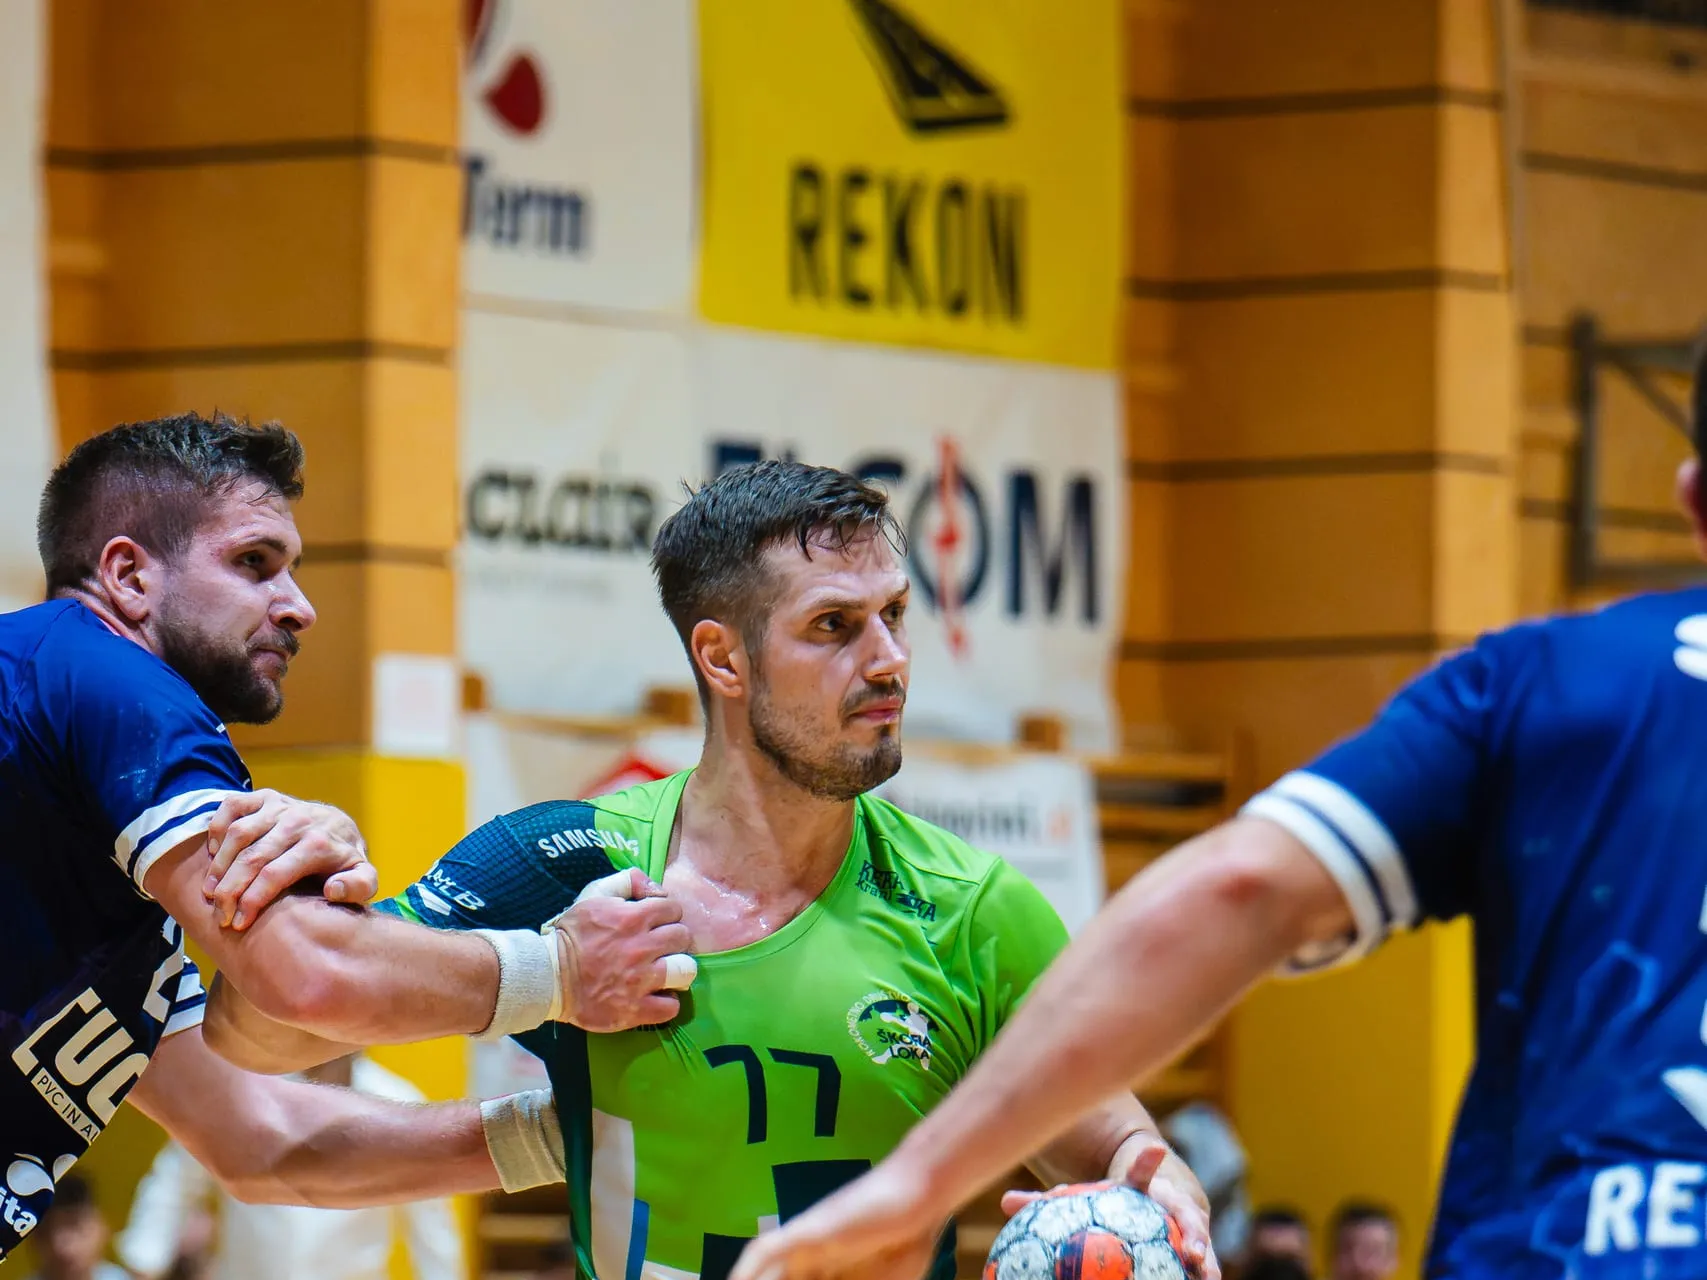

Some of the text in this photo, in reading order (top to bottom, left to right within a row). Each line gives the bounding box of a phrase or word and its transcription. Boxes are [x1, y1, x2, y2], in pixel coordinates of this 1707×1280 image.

[788, 158, 1028, 325] REKON
[37, 1075, 64, 1106] PVC
[62, 1102, 81, 1126] IN
[702, 1044, 842, 1145] 77
[889, 1045, 931, 1060] LOKA
[1584, 1161, 1707, 1257] RE
